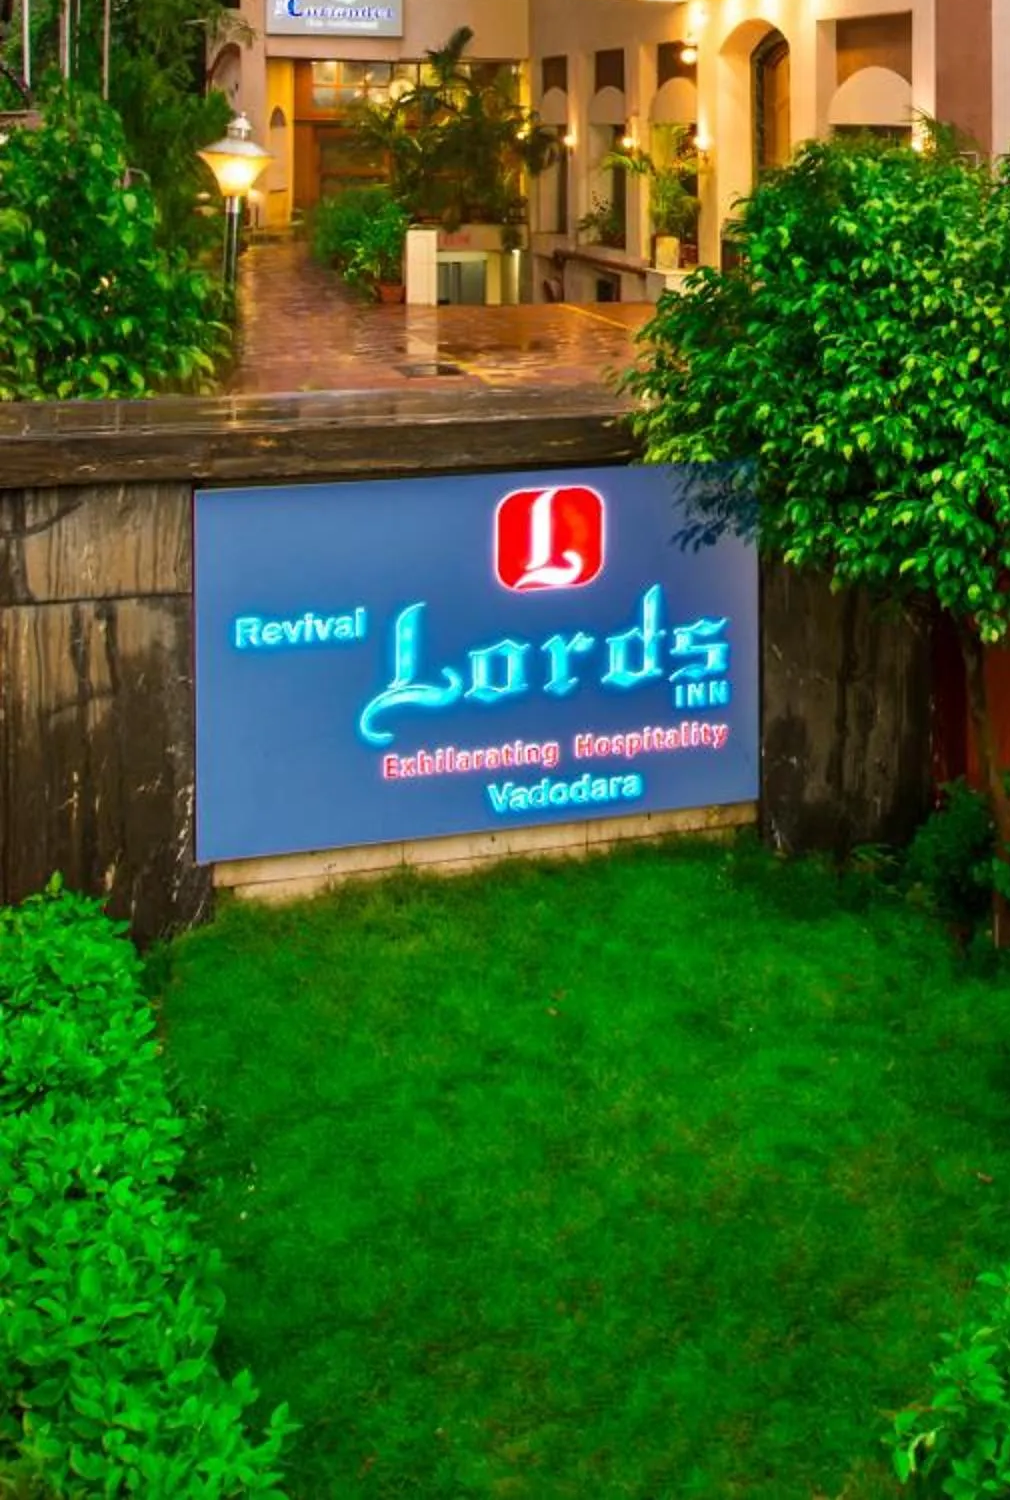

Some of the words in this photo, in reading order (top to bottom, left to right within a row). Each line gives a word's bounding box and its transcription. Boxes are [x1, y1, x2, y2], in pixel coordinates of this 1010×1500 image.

[235, 607, 367, 648] Revival
[360, 583, 729, 744] Lords
[674, 678, 729, 709] INN
[383, 740, 559, 780] Exhilarating
[575, 721, 728, 760] Hospitality
[488, 771, 643, 813] Vadodara
